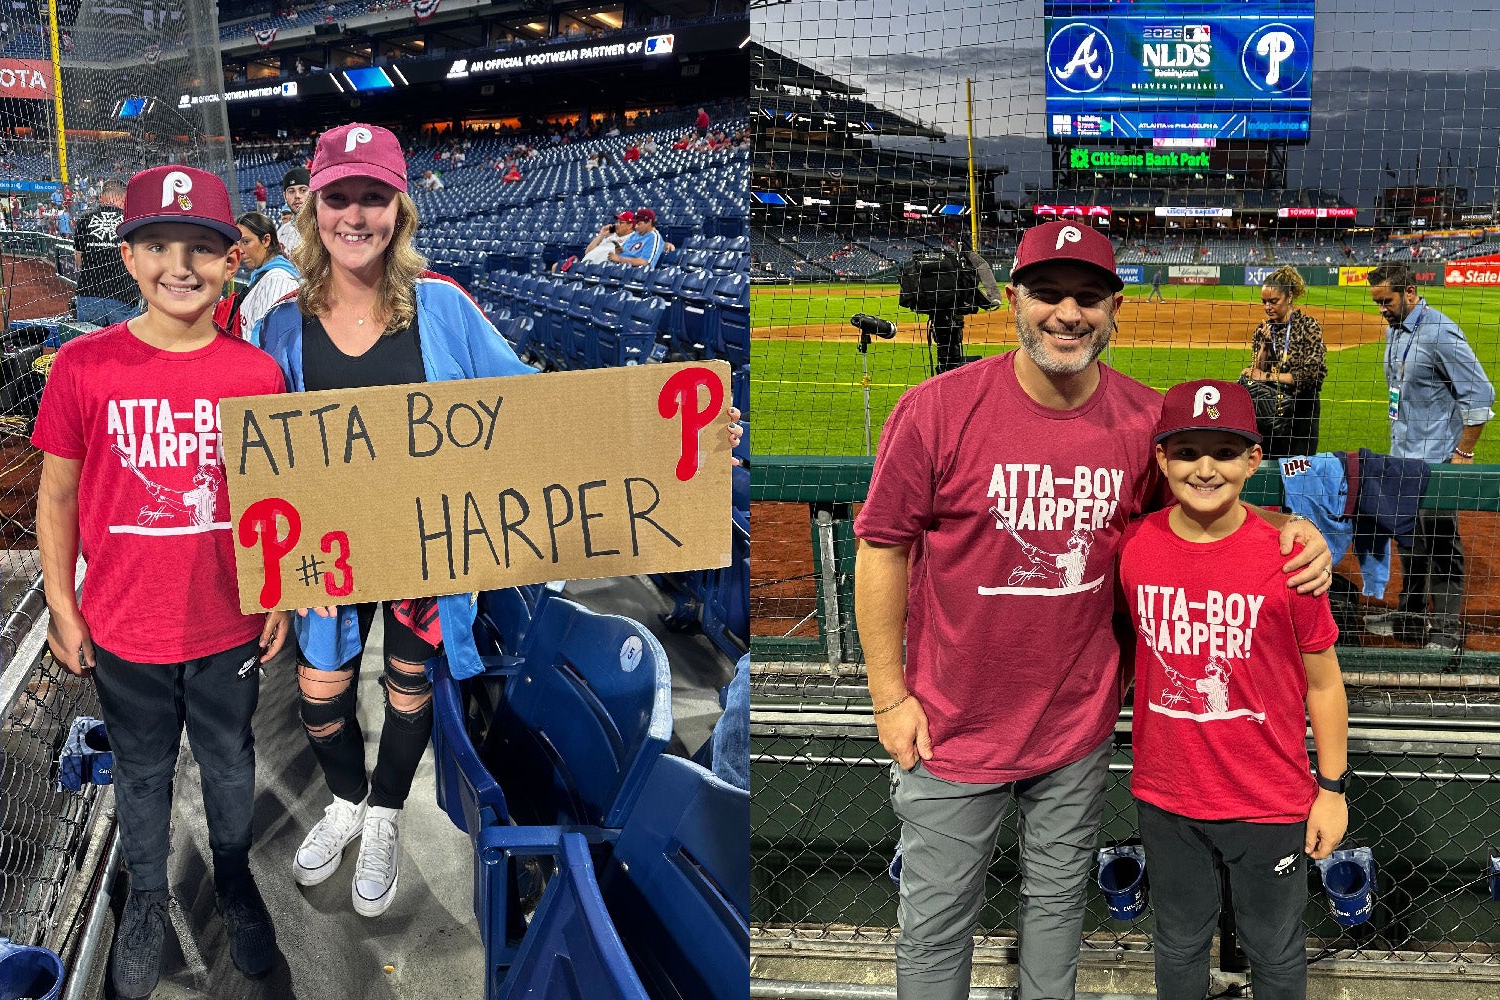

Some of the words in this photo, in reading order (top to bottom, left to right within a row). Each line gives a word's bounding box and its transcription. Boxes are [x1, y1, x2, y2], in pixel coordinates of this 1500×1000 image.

[1143, 28, 1182, 38] 2023
[471, 61, 483, 72] AN
[484, 57, 523, 71] OFFICIAL
[526, 51, 578, 65] FOOTWEAR
[580, 44, 625, 59] PARTNER
[627, 42, 642, 53] OF
[1143, 44, 1211, 67] NLDS
[1257, 32, 1294, 84] P
[345, 127, 373, 152] P
[1091, 152, 1143, 166] Citizens
[1146, 152, 1178, 165] Bank
[1180, 152, 1210, 166] Park
[162, 172, 193, 208] P
[1056, 226, 1081, 250] P
[1465, 270, 1497, 283] State
[1193, 386, 1220, 417] P
[239, 403, 376, 476] ATTA
[407, 391, 504, 458] BOY
[658, 367, 724, 481] P
[987, 464, 1124, 501] ATTA-BOY
[415, 477, 683, 580] HARPER
[996, 498, 1118, 531] HARPER!
[238, 497, 301, 609] P
[1138, 585, 1265, 629] ATTA-BOY
[1140, 618, 1252, 659] HARPER!
